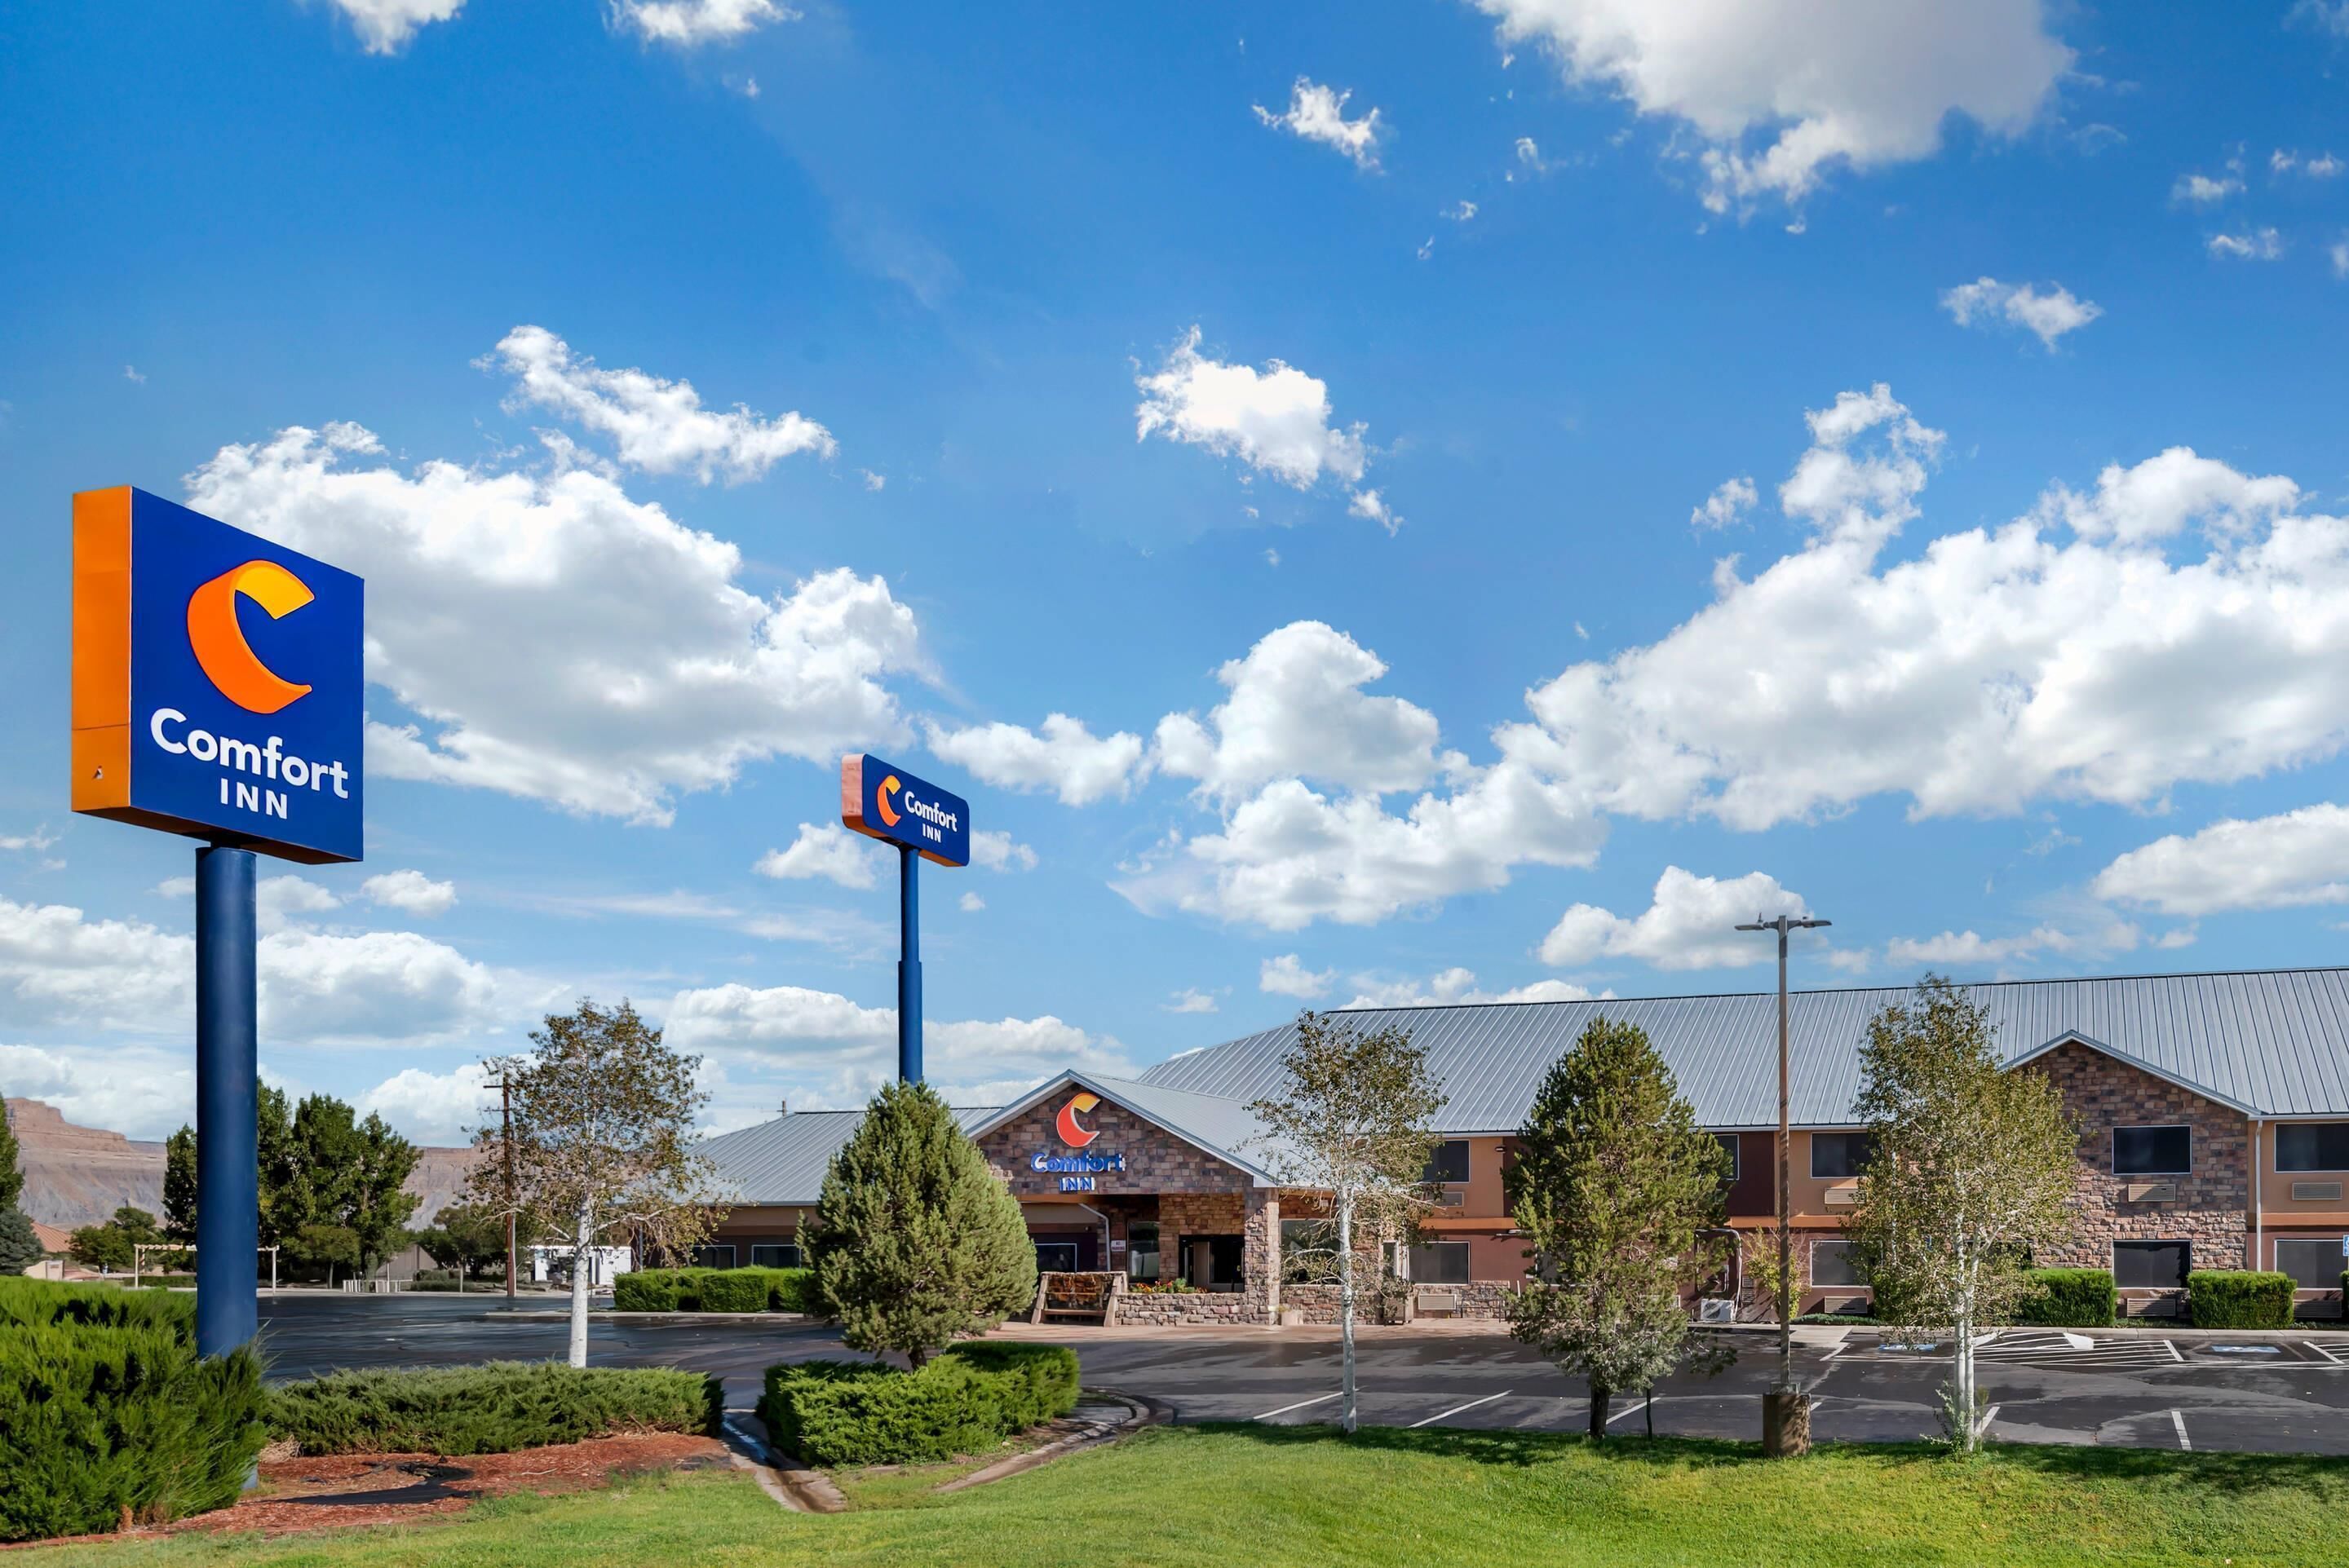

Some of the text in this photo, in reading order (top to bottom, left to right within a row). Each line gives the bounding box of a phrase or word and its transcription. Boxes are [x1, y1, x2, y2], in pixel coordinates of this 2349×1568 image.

[150, 708, 348, 799] Comfort
[220, 778, 287, 819] INN
[905, 791, 958, 832] Comfort
[922, 823, 941, 843] INN
[1030, 1151, 1126, 1173] Comfort
[1059, 1177, 1095, 1191] INN
